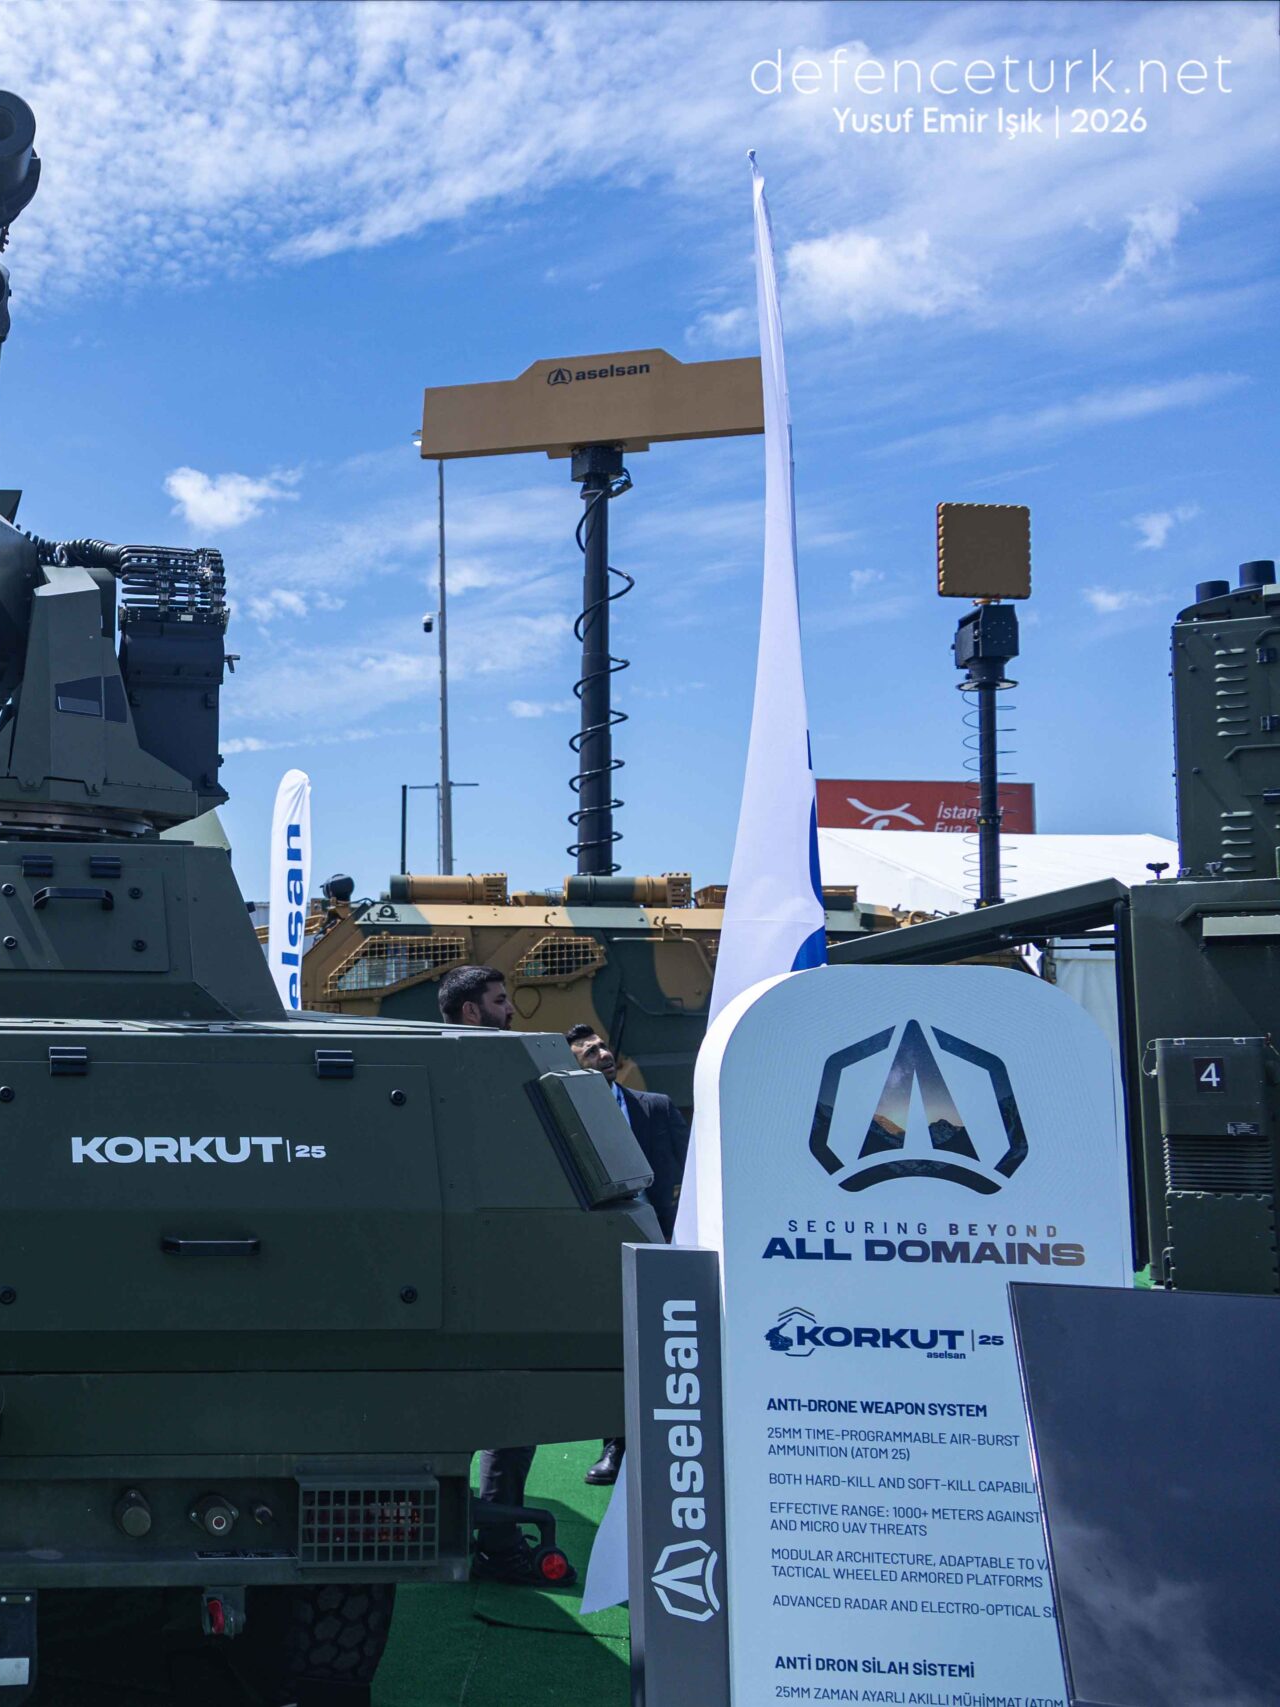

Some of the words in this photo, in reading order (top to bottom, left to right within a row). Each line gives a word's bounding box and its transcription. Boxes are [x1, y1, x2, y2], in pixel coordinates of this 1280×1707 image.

[575, 362, 651, 382] aselsan
[1199, 1062, 1220, 1087] 4
[71, 1136, 283, 1164] KORKUT
[295, 1145, 327, 1159] 25
[788, 1219, 929, 1235] SECURING
[949, 1223, 1059, 1238] BEYOND
[762, 1237, 852, 1261] ALL
[865, 1239, 1086, 1267] DOMAINS
[796, 1325, 965, 1351] KORKUT
[978, 1334, 1005, 1346] 25
[926, 1350, 967, 1360] aselsan
[653, 1299, 706, 1530] aselsan
[767, 1398, 858, 1414] ANTI-DRONE
[860, 1401, 926, 1416] WEAPON
[928, 1404, 988, 1418] SYSTEM
[767, 1427, 802, 1440] 25MM
[805, 1428, 947, 1445] TIME-PROGRAMMABLE
[949, 1433, 1020, 1447] AIR-BURST
[767, 1444, 848, 1458] AMMUNITION
[851, 1446, 889, 1460] (ATOM
[891, 1448, 911, 1461] 25)
[769, 1473, 802, 1486] BOTH
[805, 1474, 875, 1488] HARD-KILL
[878, 1477, 905, 1489] AND
[907, 1478, 976, 1492] SOFT-KILL
[770, 1501, 838, 1516] EFFECTIVE
[841, 1505, 890, 1518] RANGE:
[893, 1506, 929, 1519] 1000+
[931, 1508, 984, 1521] METERS
[986, 1510, 1040, 1524] AGAINST
[770, 1519, 797, 1531] AND
[800, 1520, 839, 1533] MICRO
[842, 1522, 868, 1534] UAV
[870, 1523, 927, 1536] THREATS
[771, 1548, 833, 1562] MODULAR
[836, 1551, 936, 1567] ARCHITECTURE,
[939, 1554, 1015, 1570] ADAPTABLE
[1017, 1557, 1035, 1570] TO
[771, 1565, 830, 1579] TACTICAL
[833, 1567, 898, 1582] WHEELED
[900, 1570, 964, 1584] ARMORED
[966, 1573, 1043, 1588] PLATFORMS
[772, 1594, 841, 1609] ADVANCED
[844, 1597, 888, 1611] RADAR
[890, 1600, 918, 1612] AND
[921, 1601, 1041, 1618] ELECTRO-OPTICAL
[775, 1654, 812, 1670] ANTİ
[815, 1657, 858, 1672] DRON
[862, 1656, 909, 1675] SİLAH
[912, 1659, 975, 1678] SİSTEMİ
[775, 1685, 811, 1699] 25MM
[814, 1687, 858, 1701] ZAMAN
[862, 1690, 906, 1703] AYARLI
[908, 1692, 949, 1705] AKILLI
[952, 1692, 1022, 1707] MÜHİMMAT
[1025, 1697, 1064, 1707] (ATOM
